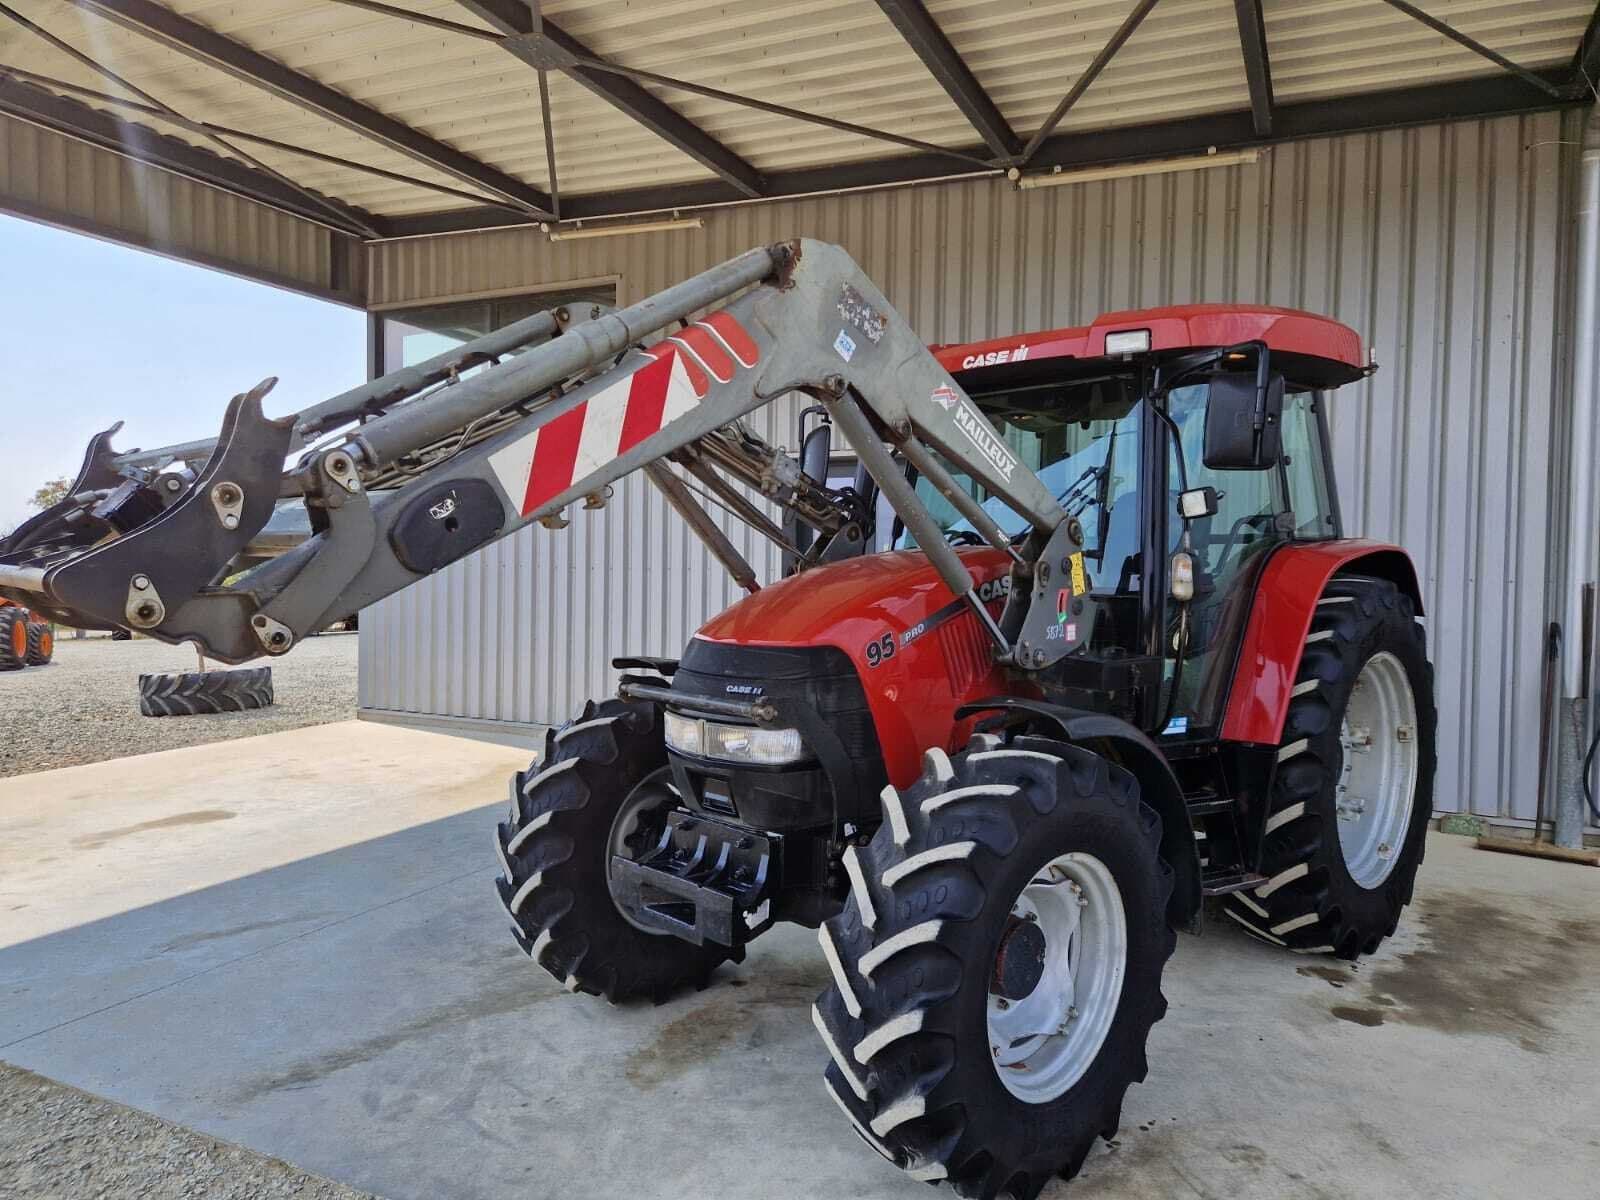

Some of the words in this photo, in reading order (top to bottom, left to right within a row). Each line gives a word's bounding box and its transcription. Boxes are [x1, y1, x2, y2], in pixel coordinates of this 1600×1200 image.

[962, 350, 1009, 369] CASE
[955, 405, 1016, 478] MAILLEUX
[979, 576, 1009, 602] CAS
[866, 631, 896, 668] 95
[905, 623, 925, 642] PRO
[726, 685, 752, 694] CASE
